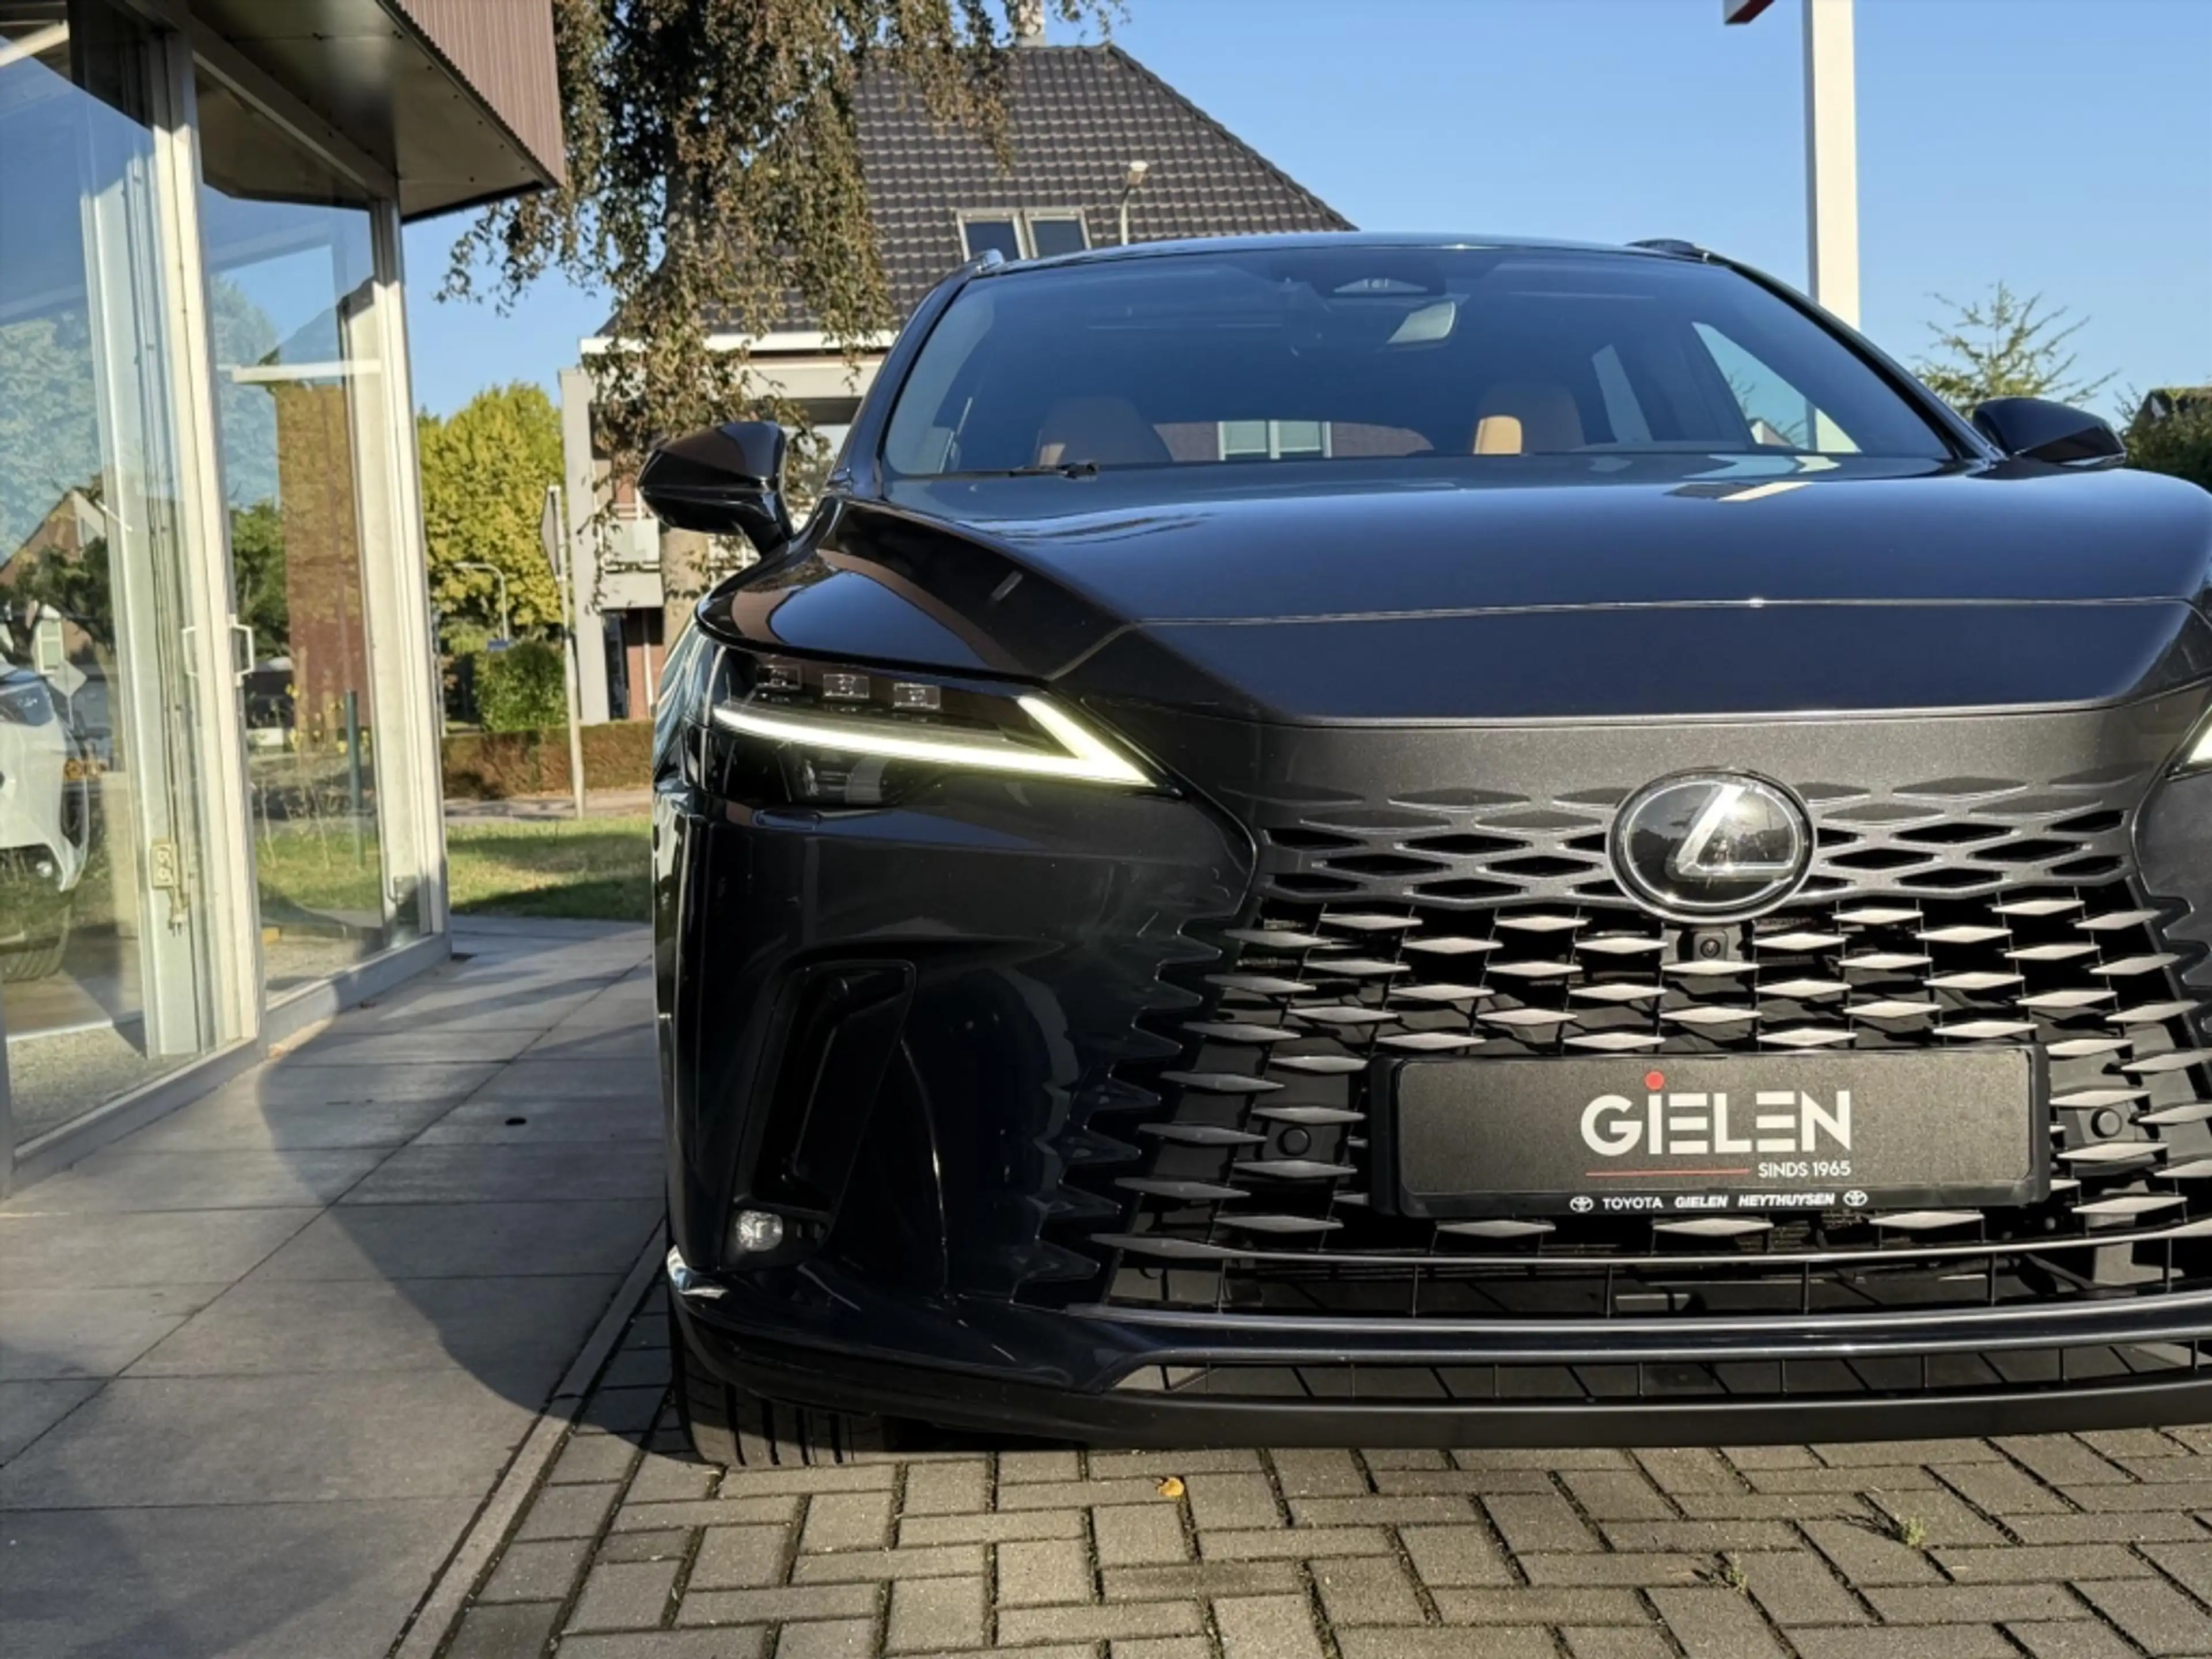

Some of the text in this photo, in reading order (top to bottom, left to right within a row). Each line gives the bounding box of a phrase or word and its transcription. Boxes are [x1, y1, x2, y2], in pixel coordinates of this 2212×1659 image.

[1581, 1071, 1851, 1156] GIELEN
[1758, 1160, 1851, 1179] SINDS 1965
[1602, 1192, 1835, 1210] TOYOTA GIELEN HEYTHUYSEN
